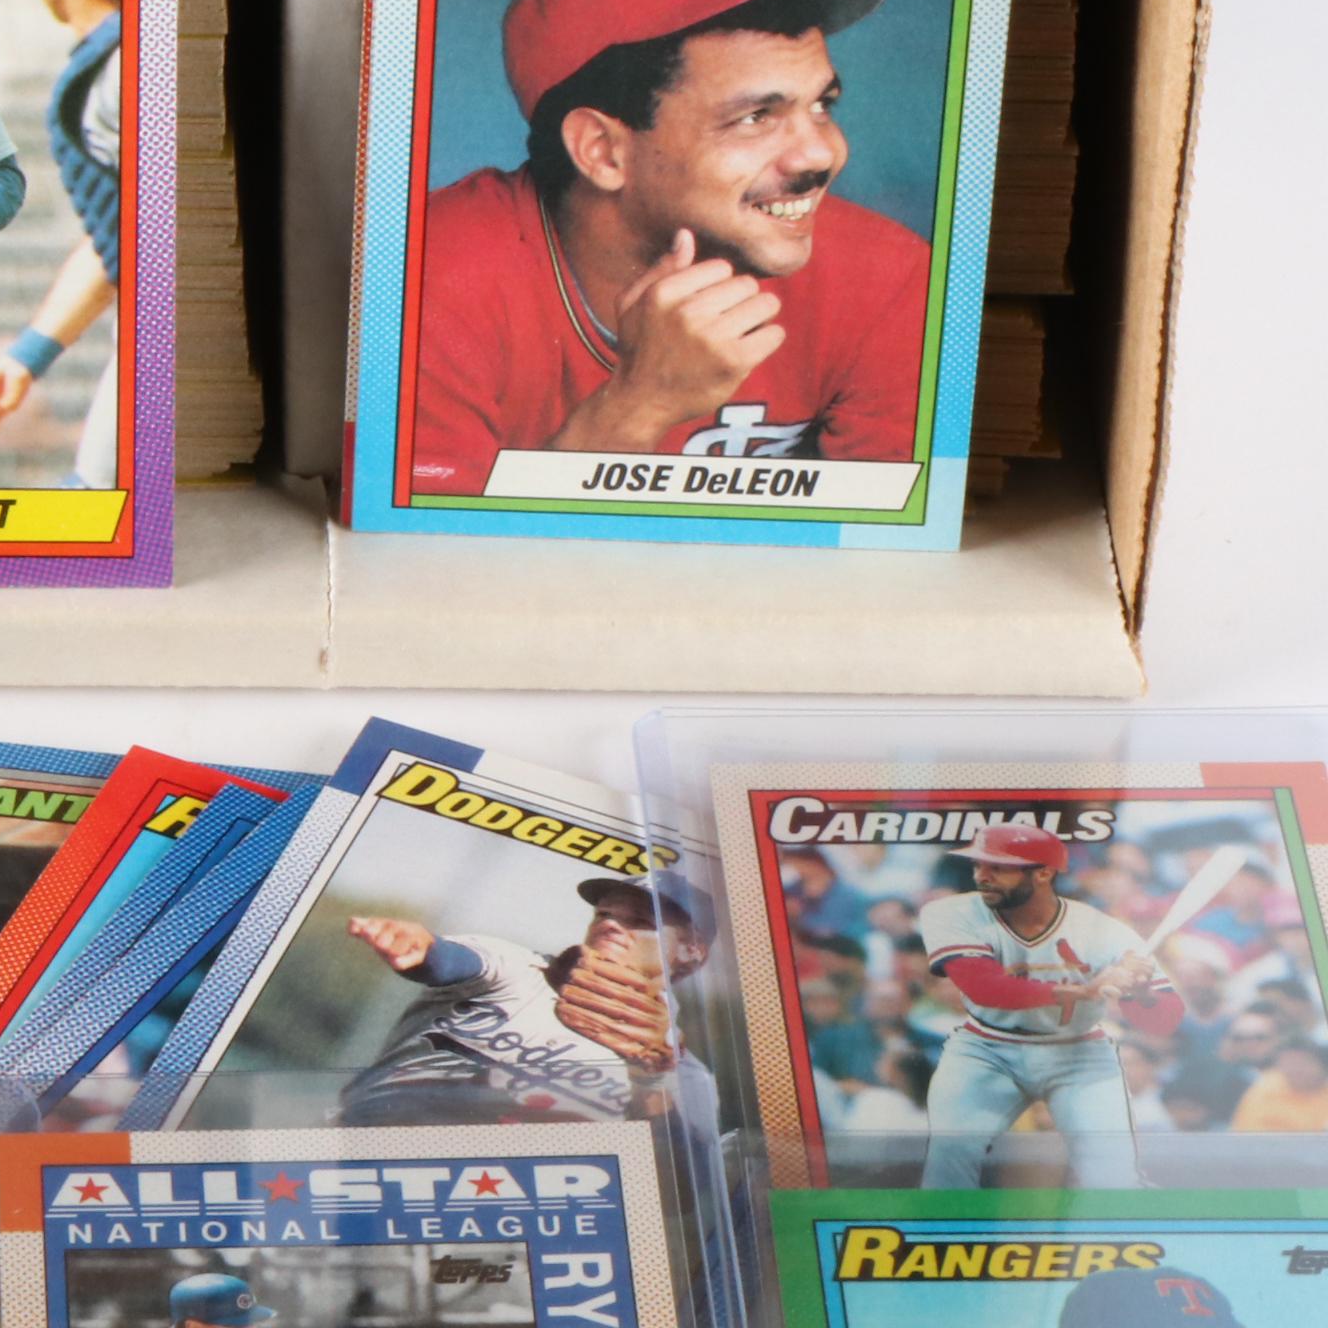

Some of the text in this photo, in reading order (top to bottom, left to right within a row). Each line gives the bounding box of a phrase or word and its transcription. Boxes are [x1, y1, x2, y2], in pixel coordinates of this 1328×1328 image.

[582, 463, 820, 497] JOSE DeLEON
[381, 762, 679, 877] DODGERS
[49, 1165, 609, 1209] ALL STAR
[68, 1214, 599, 1244] NATIONAL LEAGUE
[838, 1227, 1162, 1279] RANGERS
[541, 1252, 620, 1328] RY
